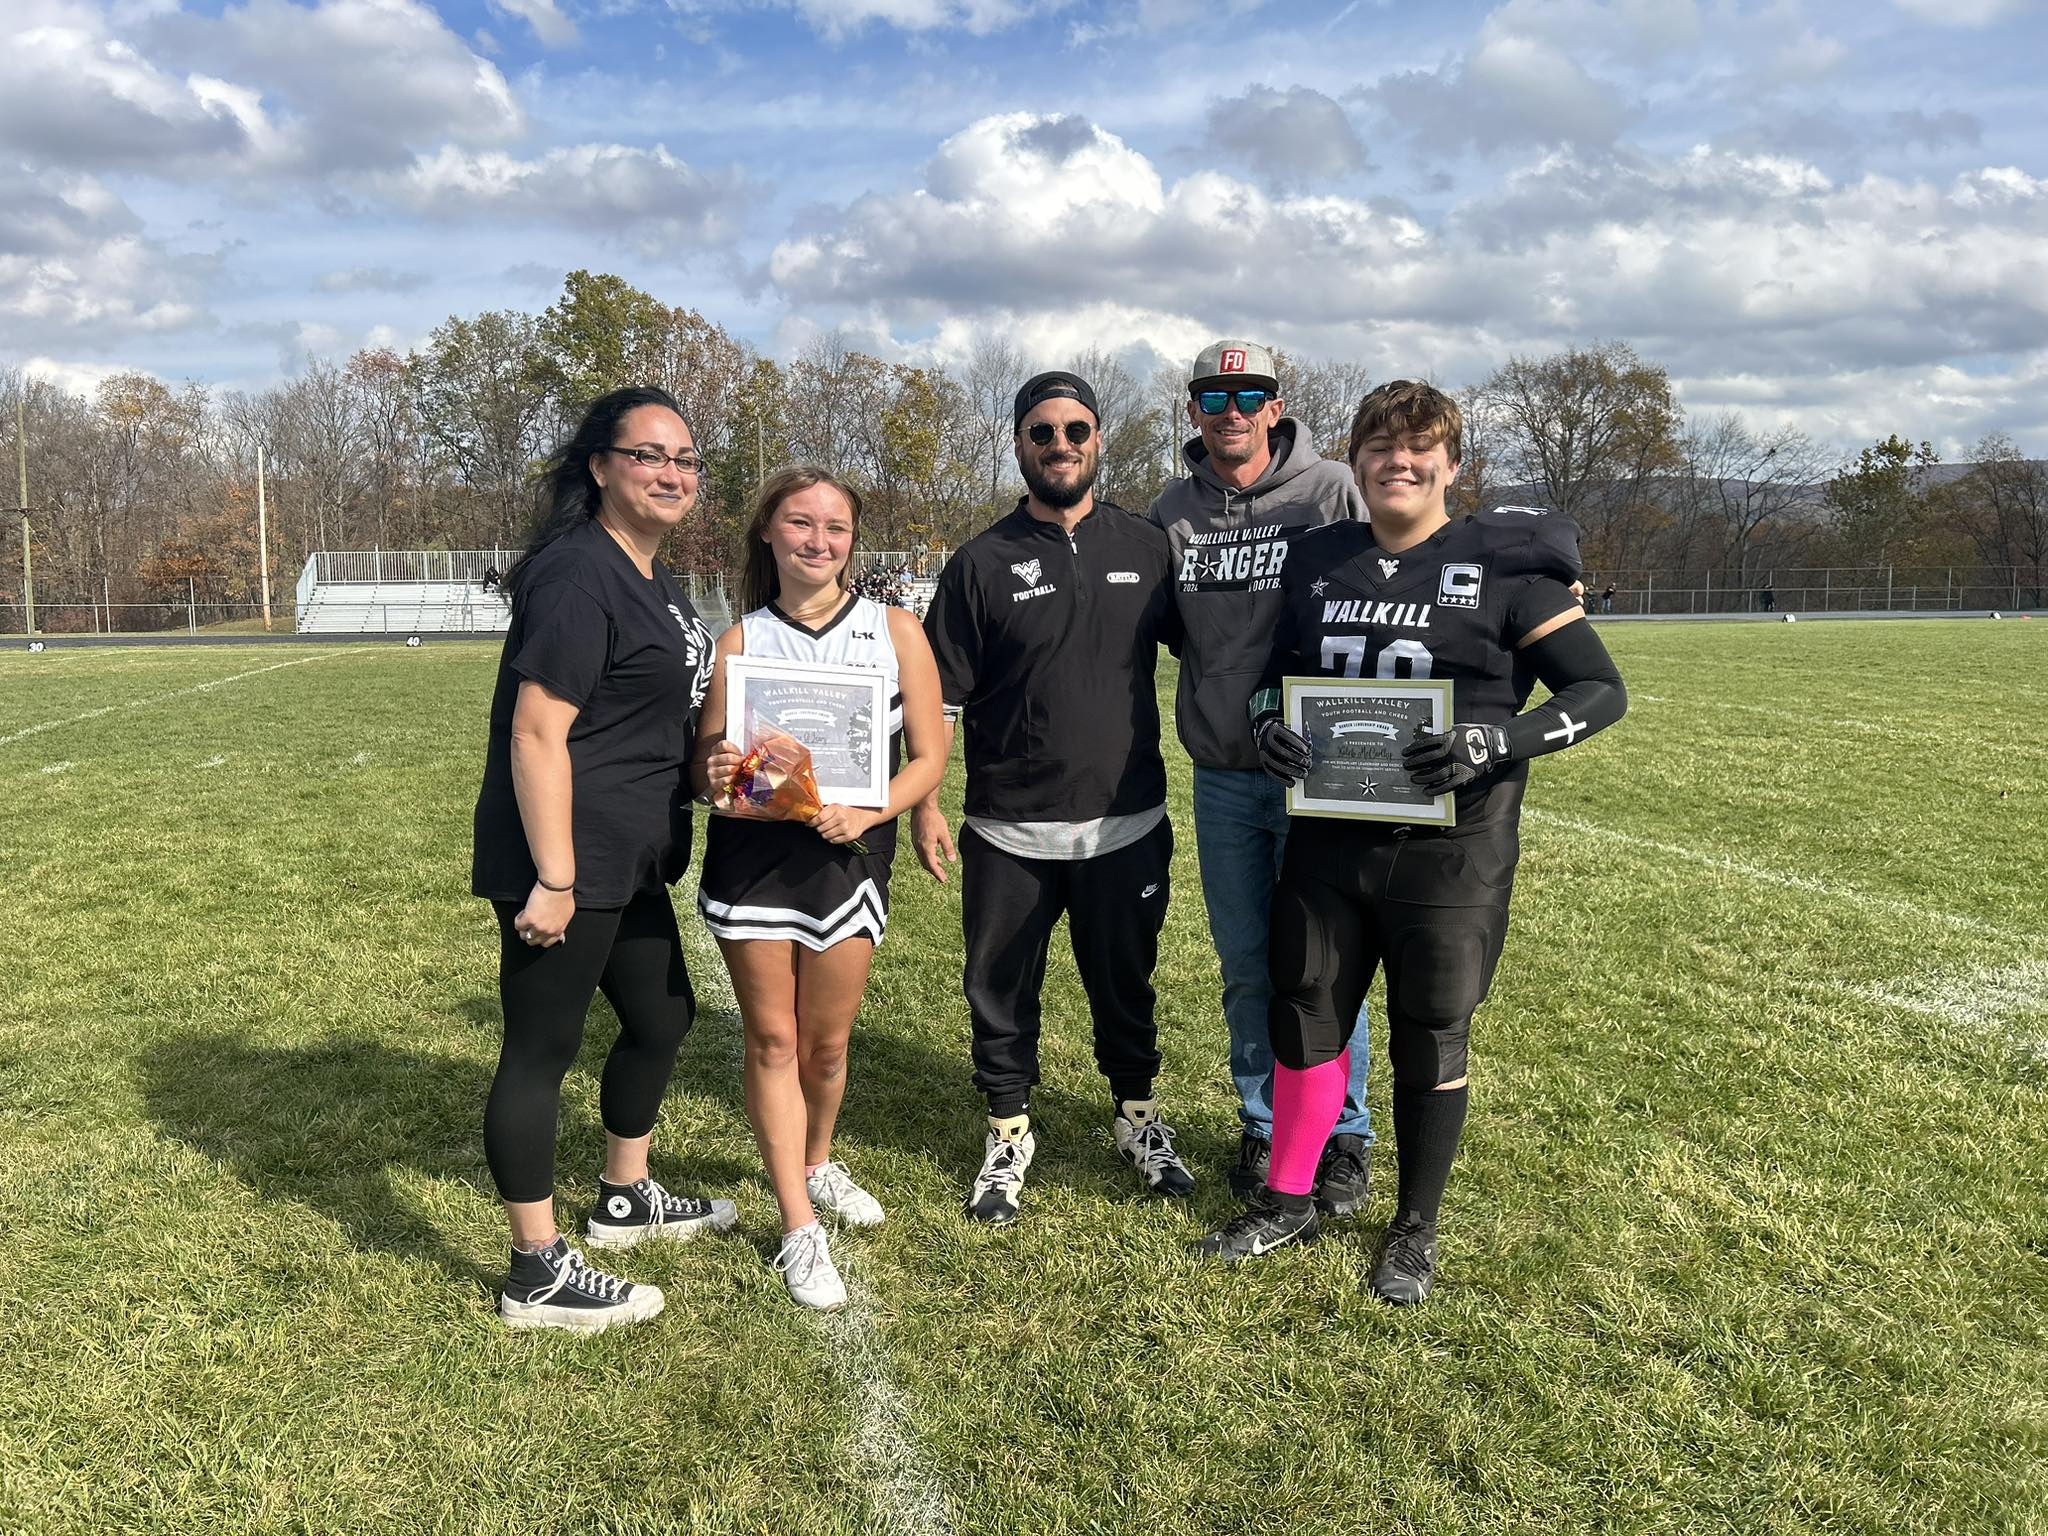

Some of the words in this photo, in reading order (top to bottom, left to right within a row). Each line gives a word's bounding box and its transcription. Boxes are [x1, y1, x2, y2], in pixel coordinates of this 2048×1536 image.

[1224, 351, 1243, 370] FD
[1188, 529, 1239, 545] WALLKILL
[1183, 583, 1199, 592] 2024
[1442, 566, 1480, 597] C
[1012, 583, 1057, 602] FOOTBALL
[1321, 599, 1432, 628] WALLKILL
[29, 642, 43, 652] 30
[407, 636, 420, 646] 40
[763, 687, 809, 697] WALLKILL
[812, 688, 848, 700] VALLEY
[1316, 697, 1366, 708] WALLKILL
[1370, 697, 1410, 709] VALLEY
[1321, 710, 1340, 718] YOUTH
[1388, 711, 1408, 720] CHEER
[1376, 723, 1390, 731] AWARD
